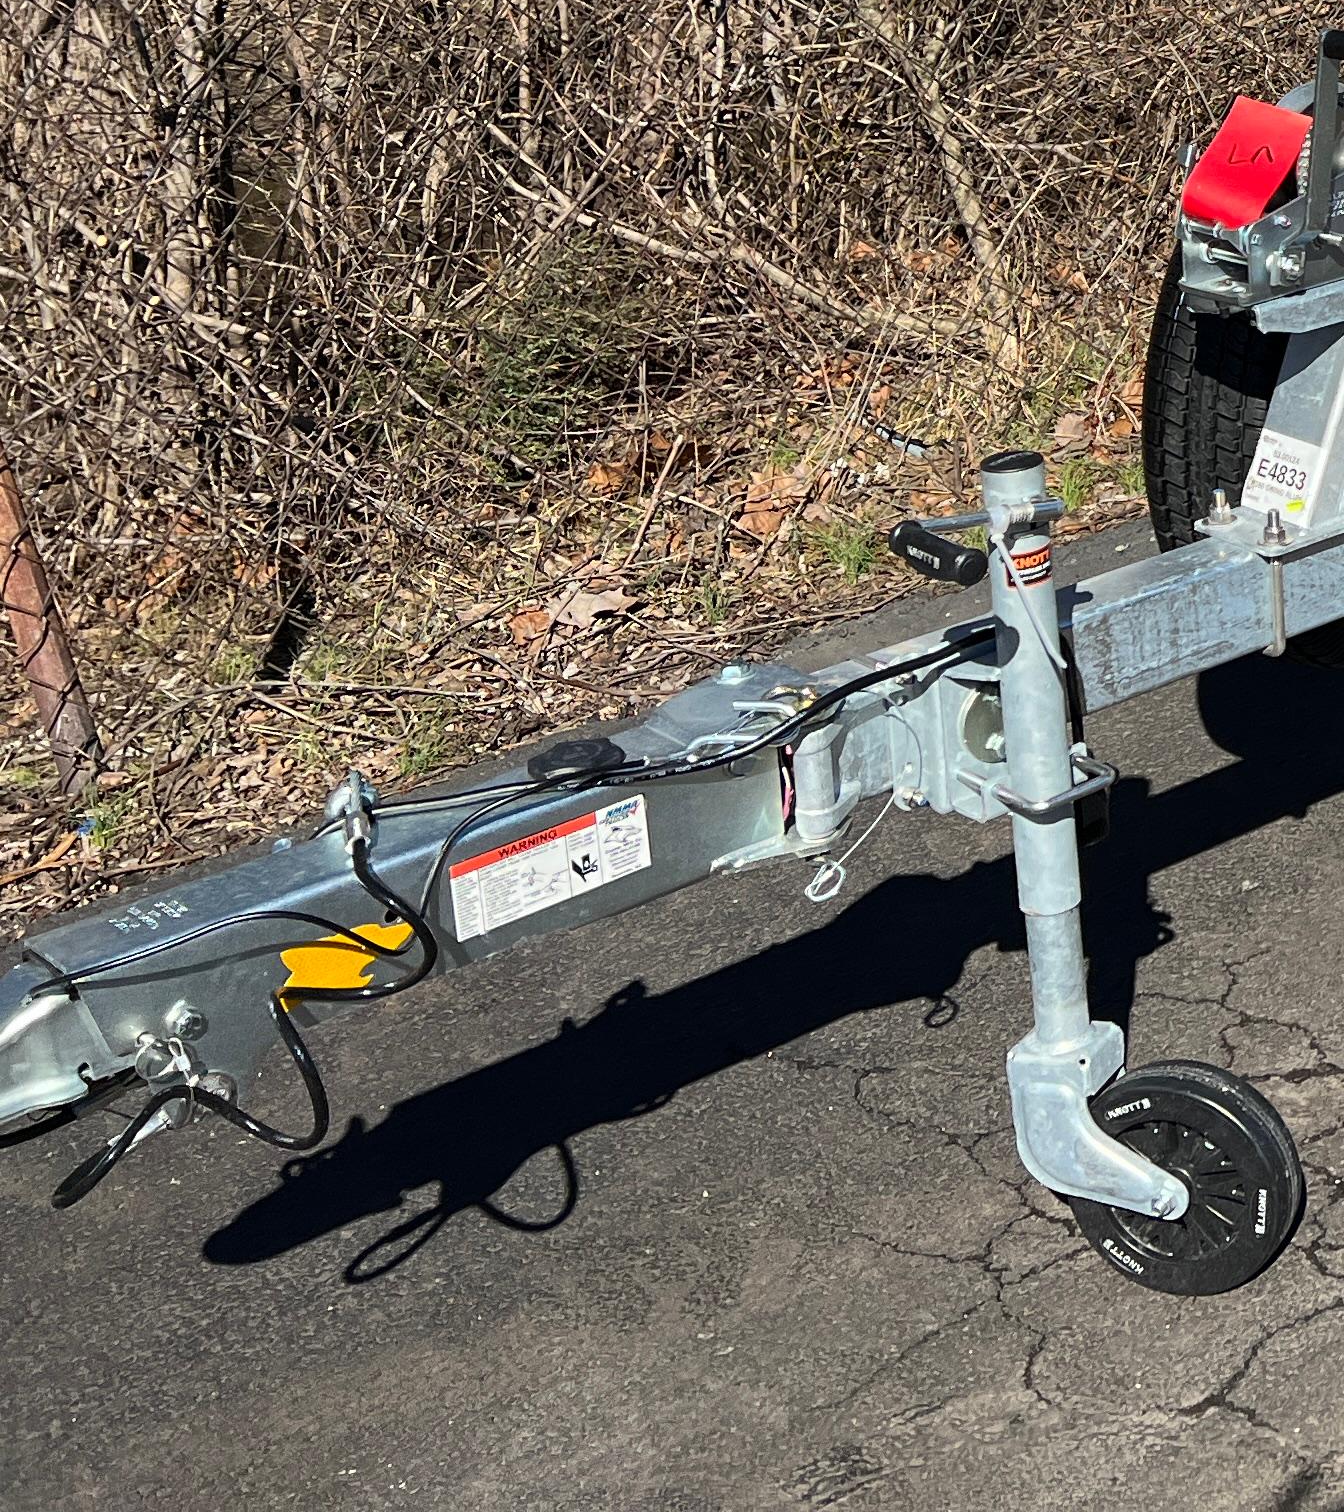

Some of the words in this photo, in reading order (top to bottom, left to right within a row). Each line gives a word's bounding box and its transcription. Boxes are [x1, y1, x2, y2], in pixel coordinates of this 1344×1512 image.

[1257, 458, 1307, 491] E4833
[497, 829, 558, 858] WARNING
[1107, 1099, 1141, 1120] KNOTT
[1110, 1246, 1144, 1275] KNOTT
